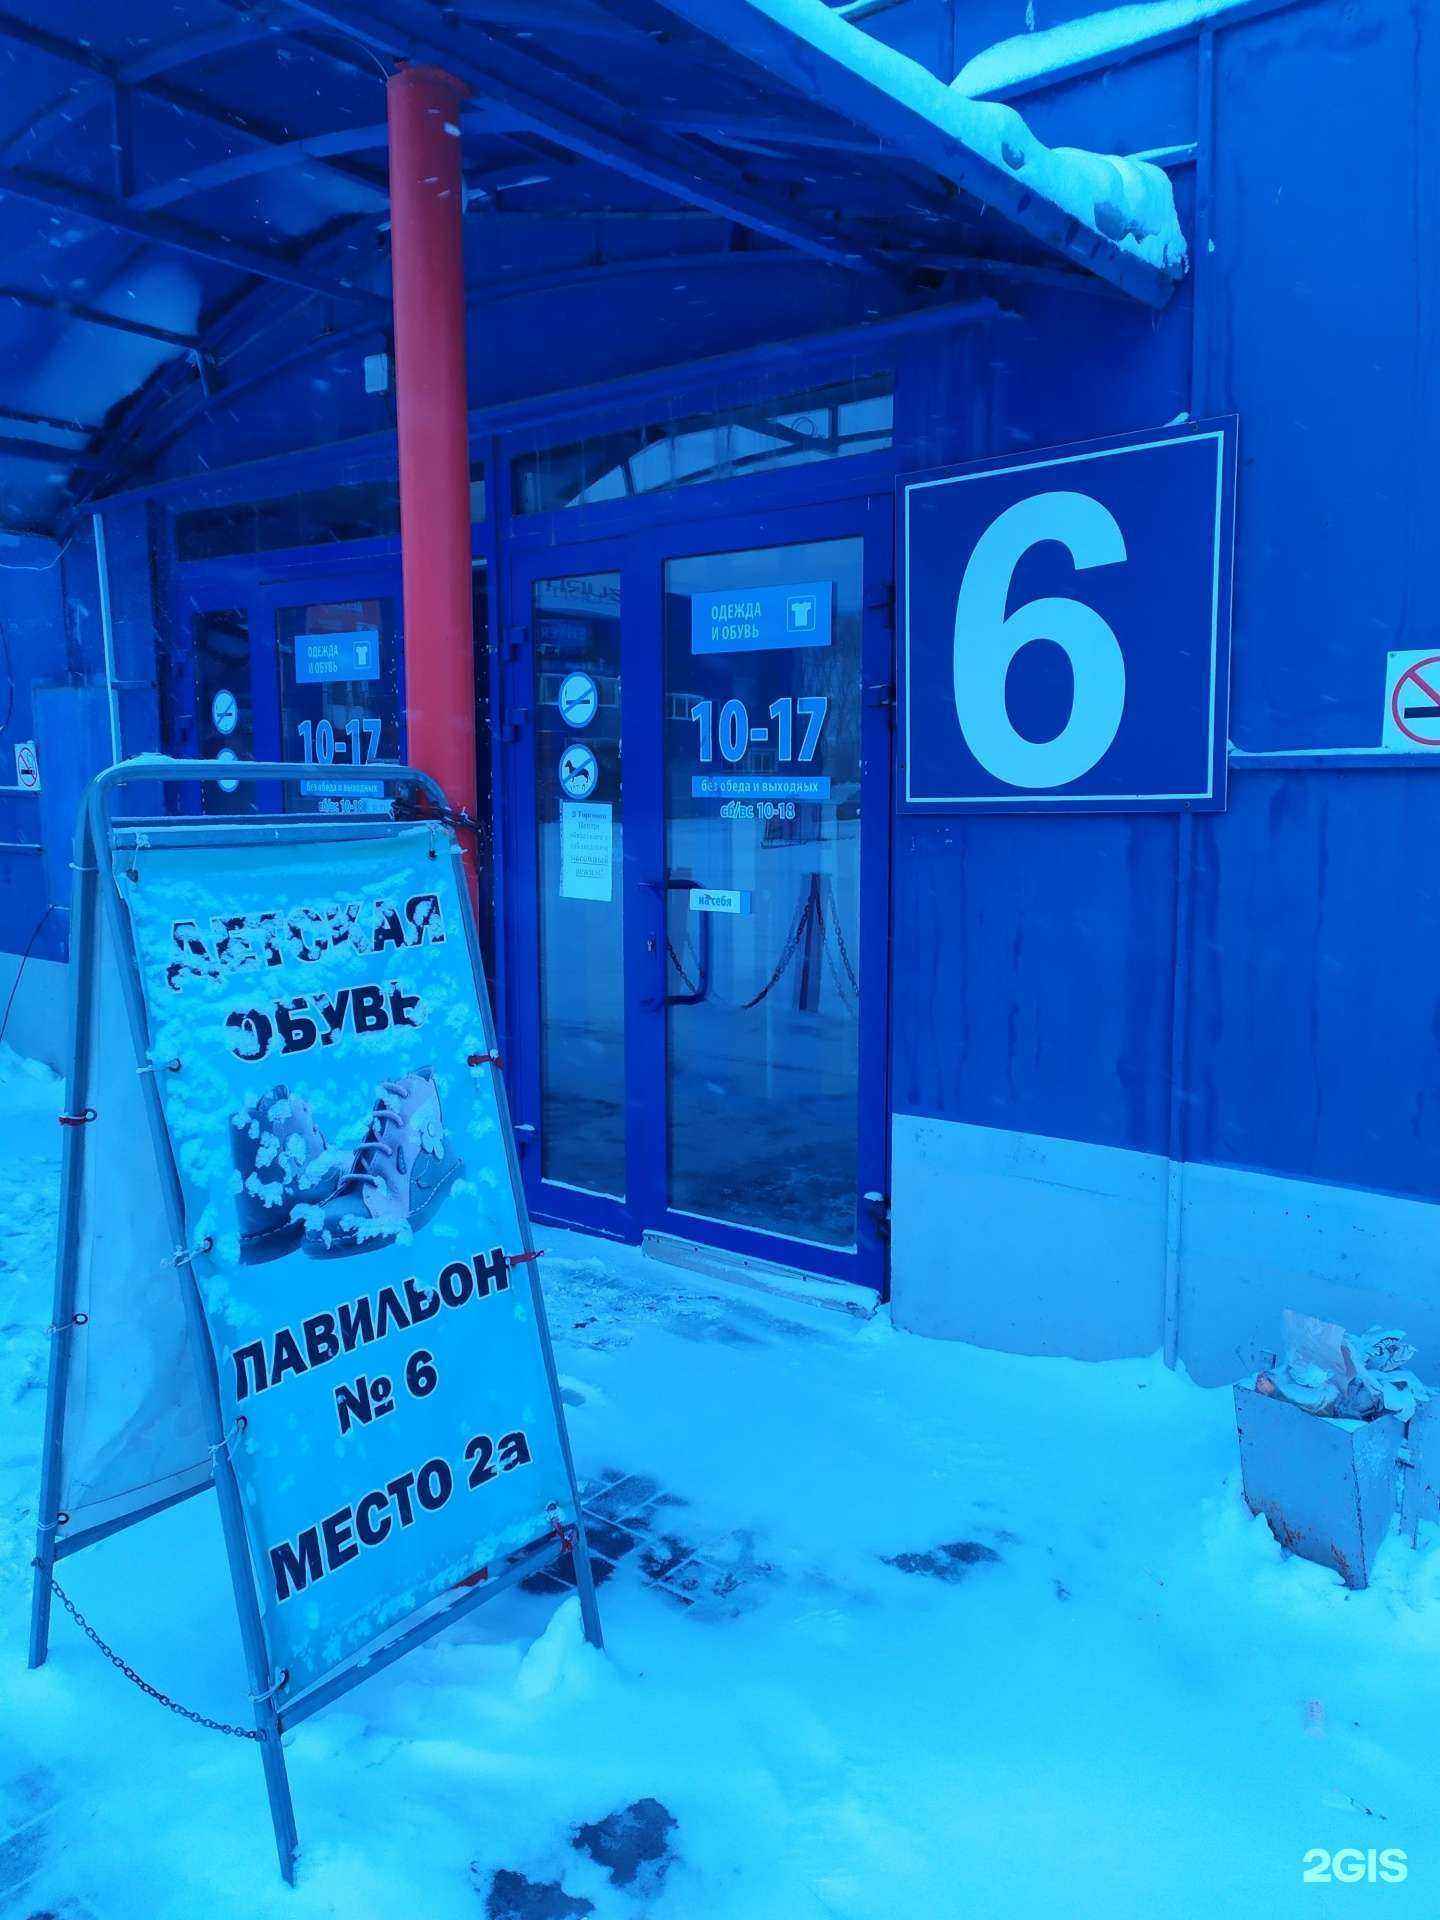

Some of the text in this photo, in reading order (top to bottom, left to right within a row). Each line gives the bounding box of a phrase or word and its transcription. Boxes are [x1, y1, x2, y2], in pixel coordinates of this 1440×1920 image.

[711, 602, 762, 622] ОДЕЖДА
[711, 623, 760, 641] И ОБУВЬ
[953, 490, 1128, 789] 6
[298, 718, 382, 766] 10-17
[690, 696, 828, 762] 10-17
[701, 779, 819, 793] без обеда и выходных
[720, 800, 796, 820] сб/вс 10-18
[225, 981, 428, 1062] ОБУВЬ
[233, 1247, 512, 1402] ПАВИЛЬОН
[334, 1349, 438, 1434] № 6
[269, 1430, 534, 1602] МЕСТО 2а
